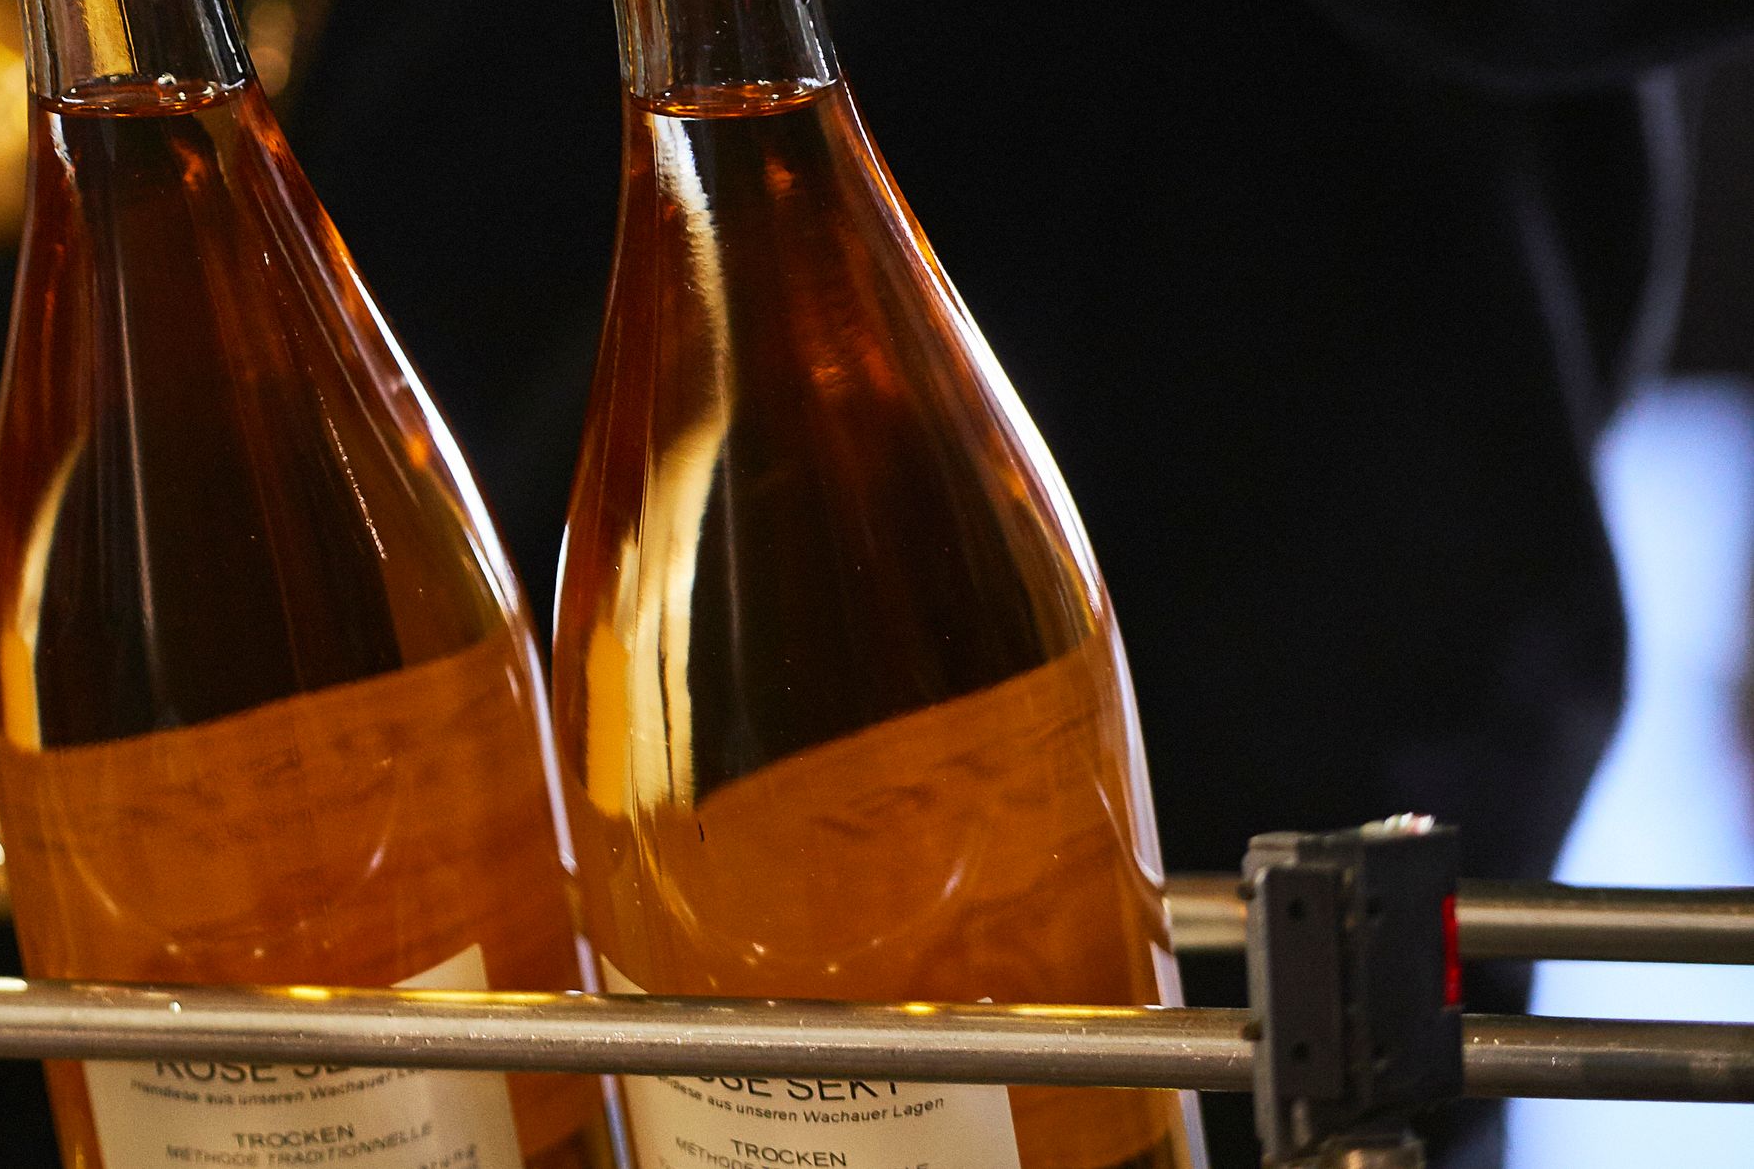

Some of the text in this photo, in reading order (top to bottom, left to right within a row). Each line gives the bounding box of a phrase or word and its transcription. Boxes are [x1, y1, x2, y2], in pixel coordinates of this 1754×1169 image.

[708, 1094, 732, 1111] aus
[736, 1103, 797, 1122] unseren
[803, 1108, 888, 1124] Wachauer
[893, 1096, 945, 1117] Lagen
[234, 1122, 355, 1149] TROCKEN
[730, 1138, 847, 1168] TROCKEN
